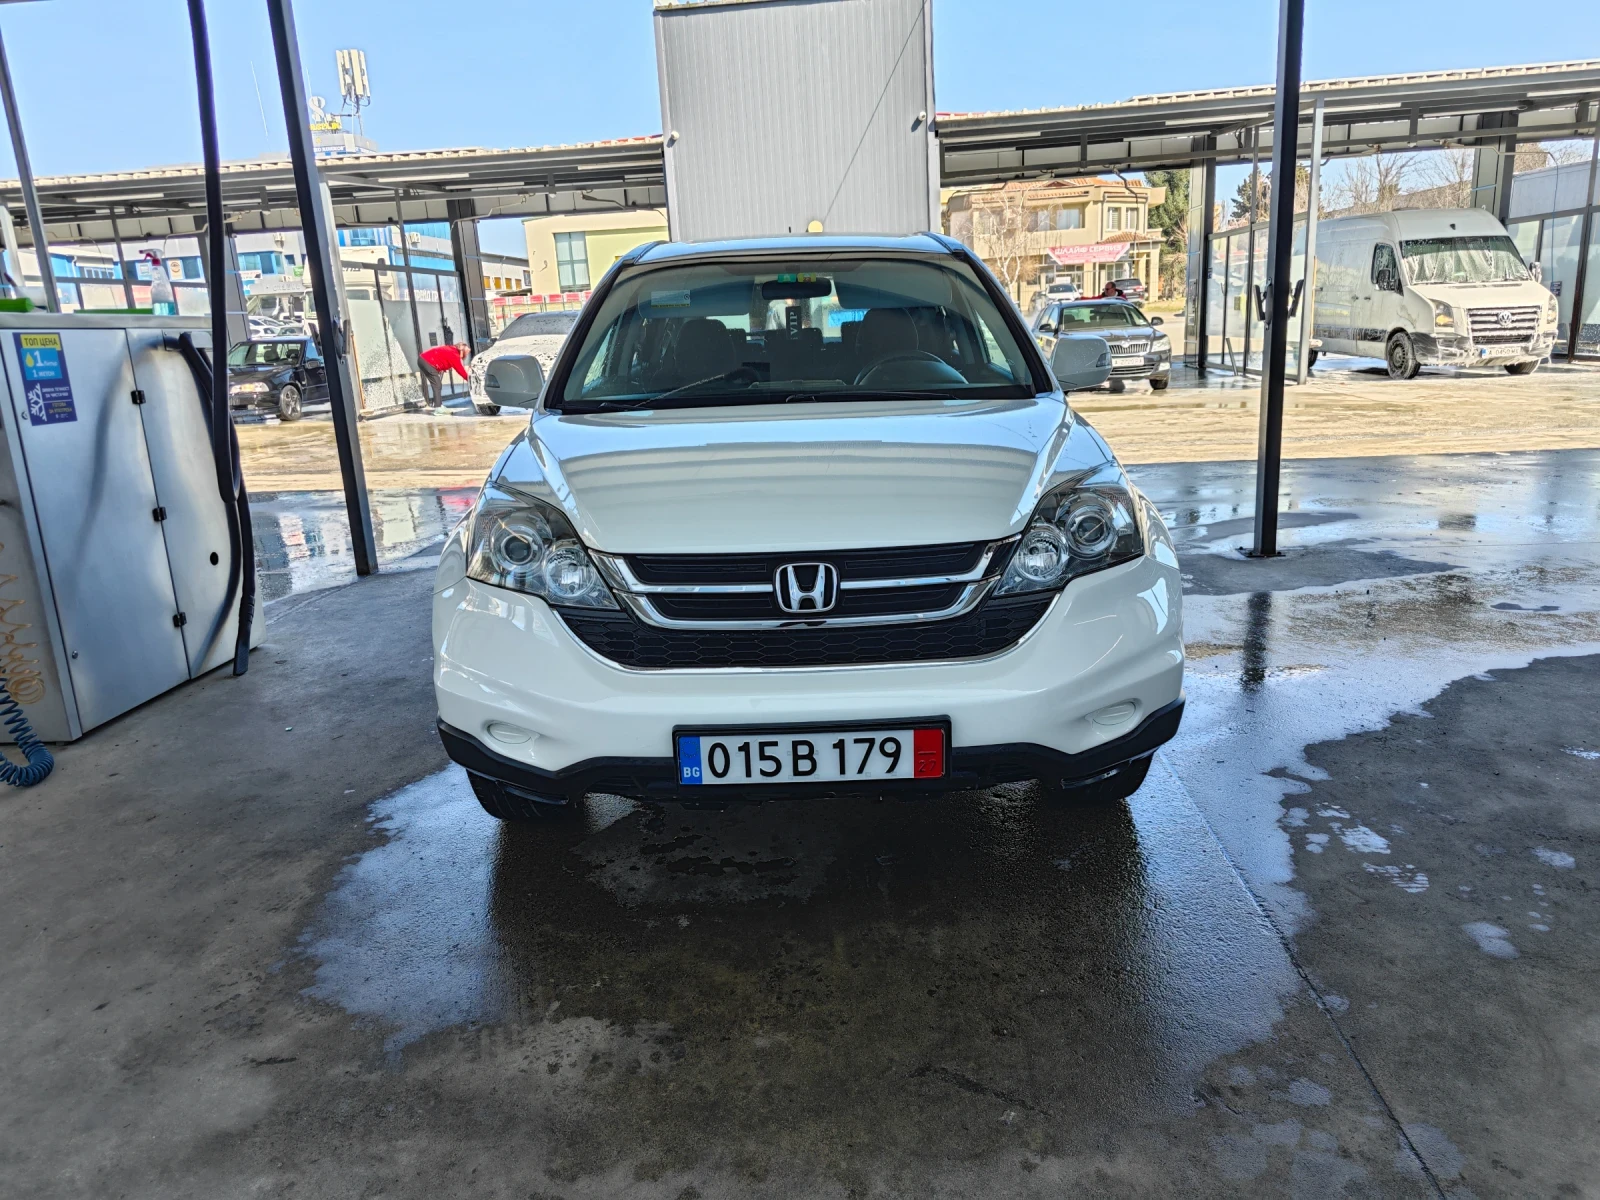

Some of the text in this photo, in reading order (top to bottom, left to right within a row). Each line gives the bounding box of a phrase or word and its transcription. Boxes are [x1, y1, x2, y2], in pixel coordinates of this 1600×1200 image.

[1089, 244, 1122, 253] СЕРВИЗ
[789, 311, 798, 335] VIP
[24, 337, 58, 347] ТОП ЦЕНА
[34, 350, 44, 366] 1
[32, 369, 38, 378] 1
[832, 736, 902, 775] 179
[683, 766, 700, 778] BG
[918, 759, 937, 773] 27
